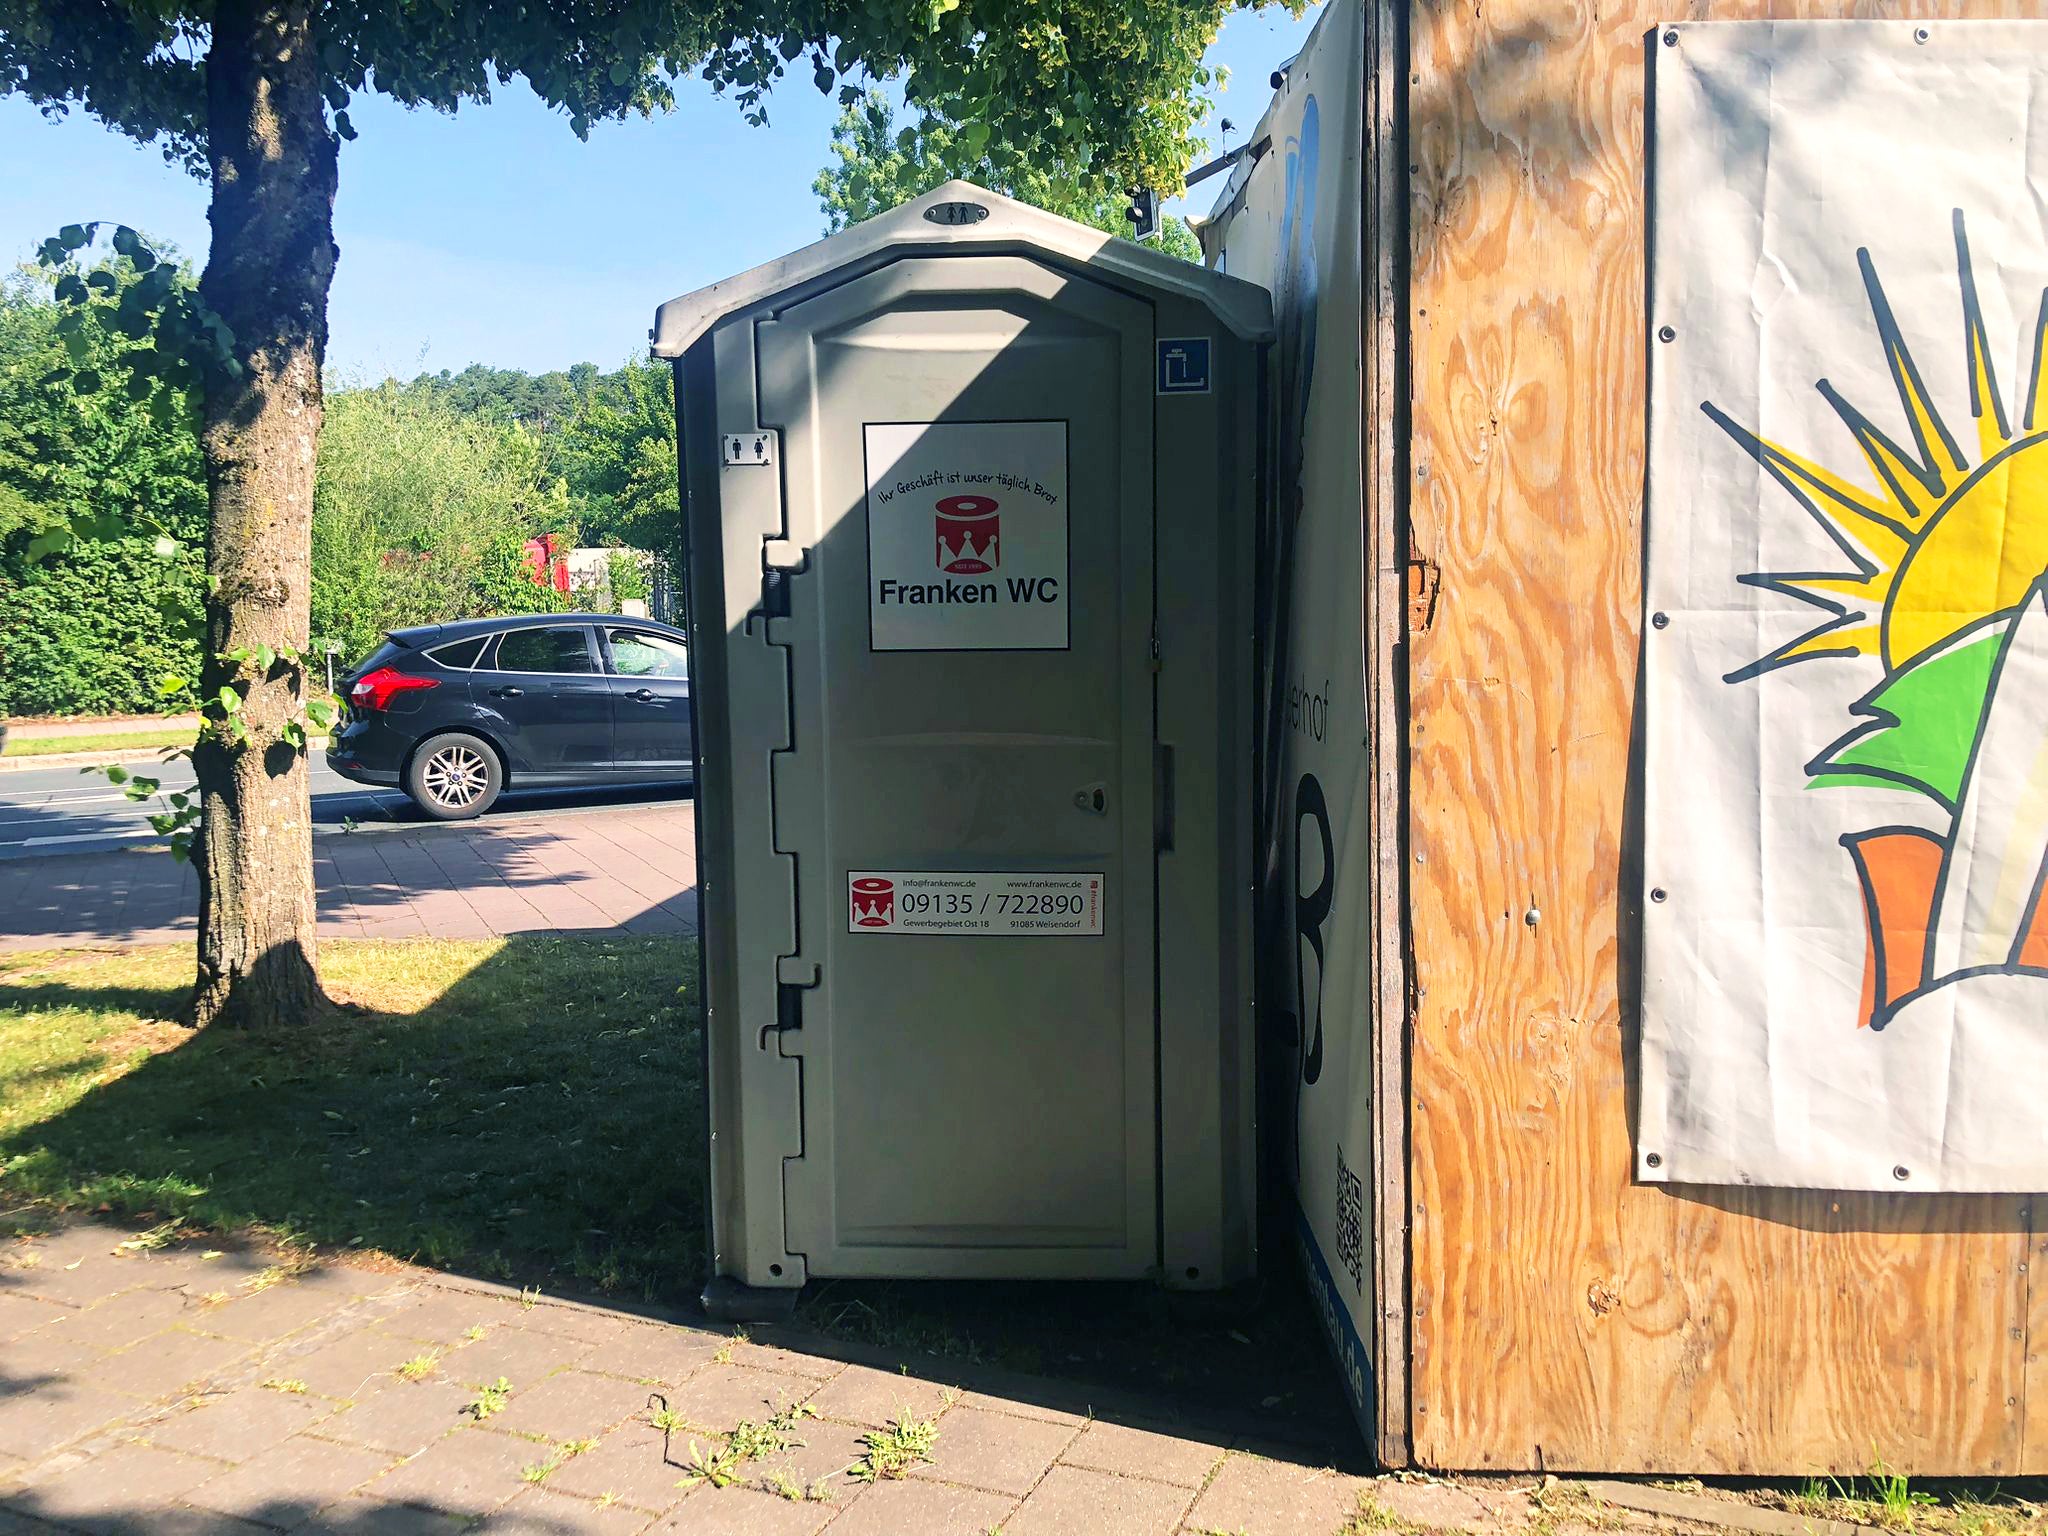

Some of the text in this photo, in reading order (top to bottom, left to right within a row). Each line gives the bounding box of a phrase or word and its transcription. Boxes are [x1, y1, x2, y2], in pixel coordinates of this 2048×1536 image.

[878, 470, 1059, 505] Ihr Geschäft ist unser täglich Brot
[879, 577, 1059, 605] Franken WC
[902, 879, 976, 888] info@frankenwc.de
[1007, 880, 1082, 889] www.frankenwc.de
[901, 893, 1084, 915] 09135 / 722890
[903, 919, 990, 930] Gewerbegebiet Ost 18
[1010, 919, 1081, 929] 91085 Weisendorf
